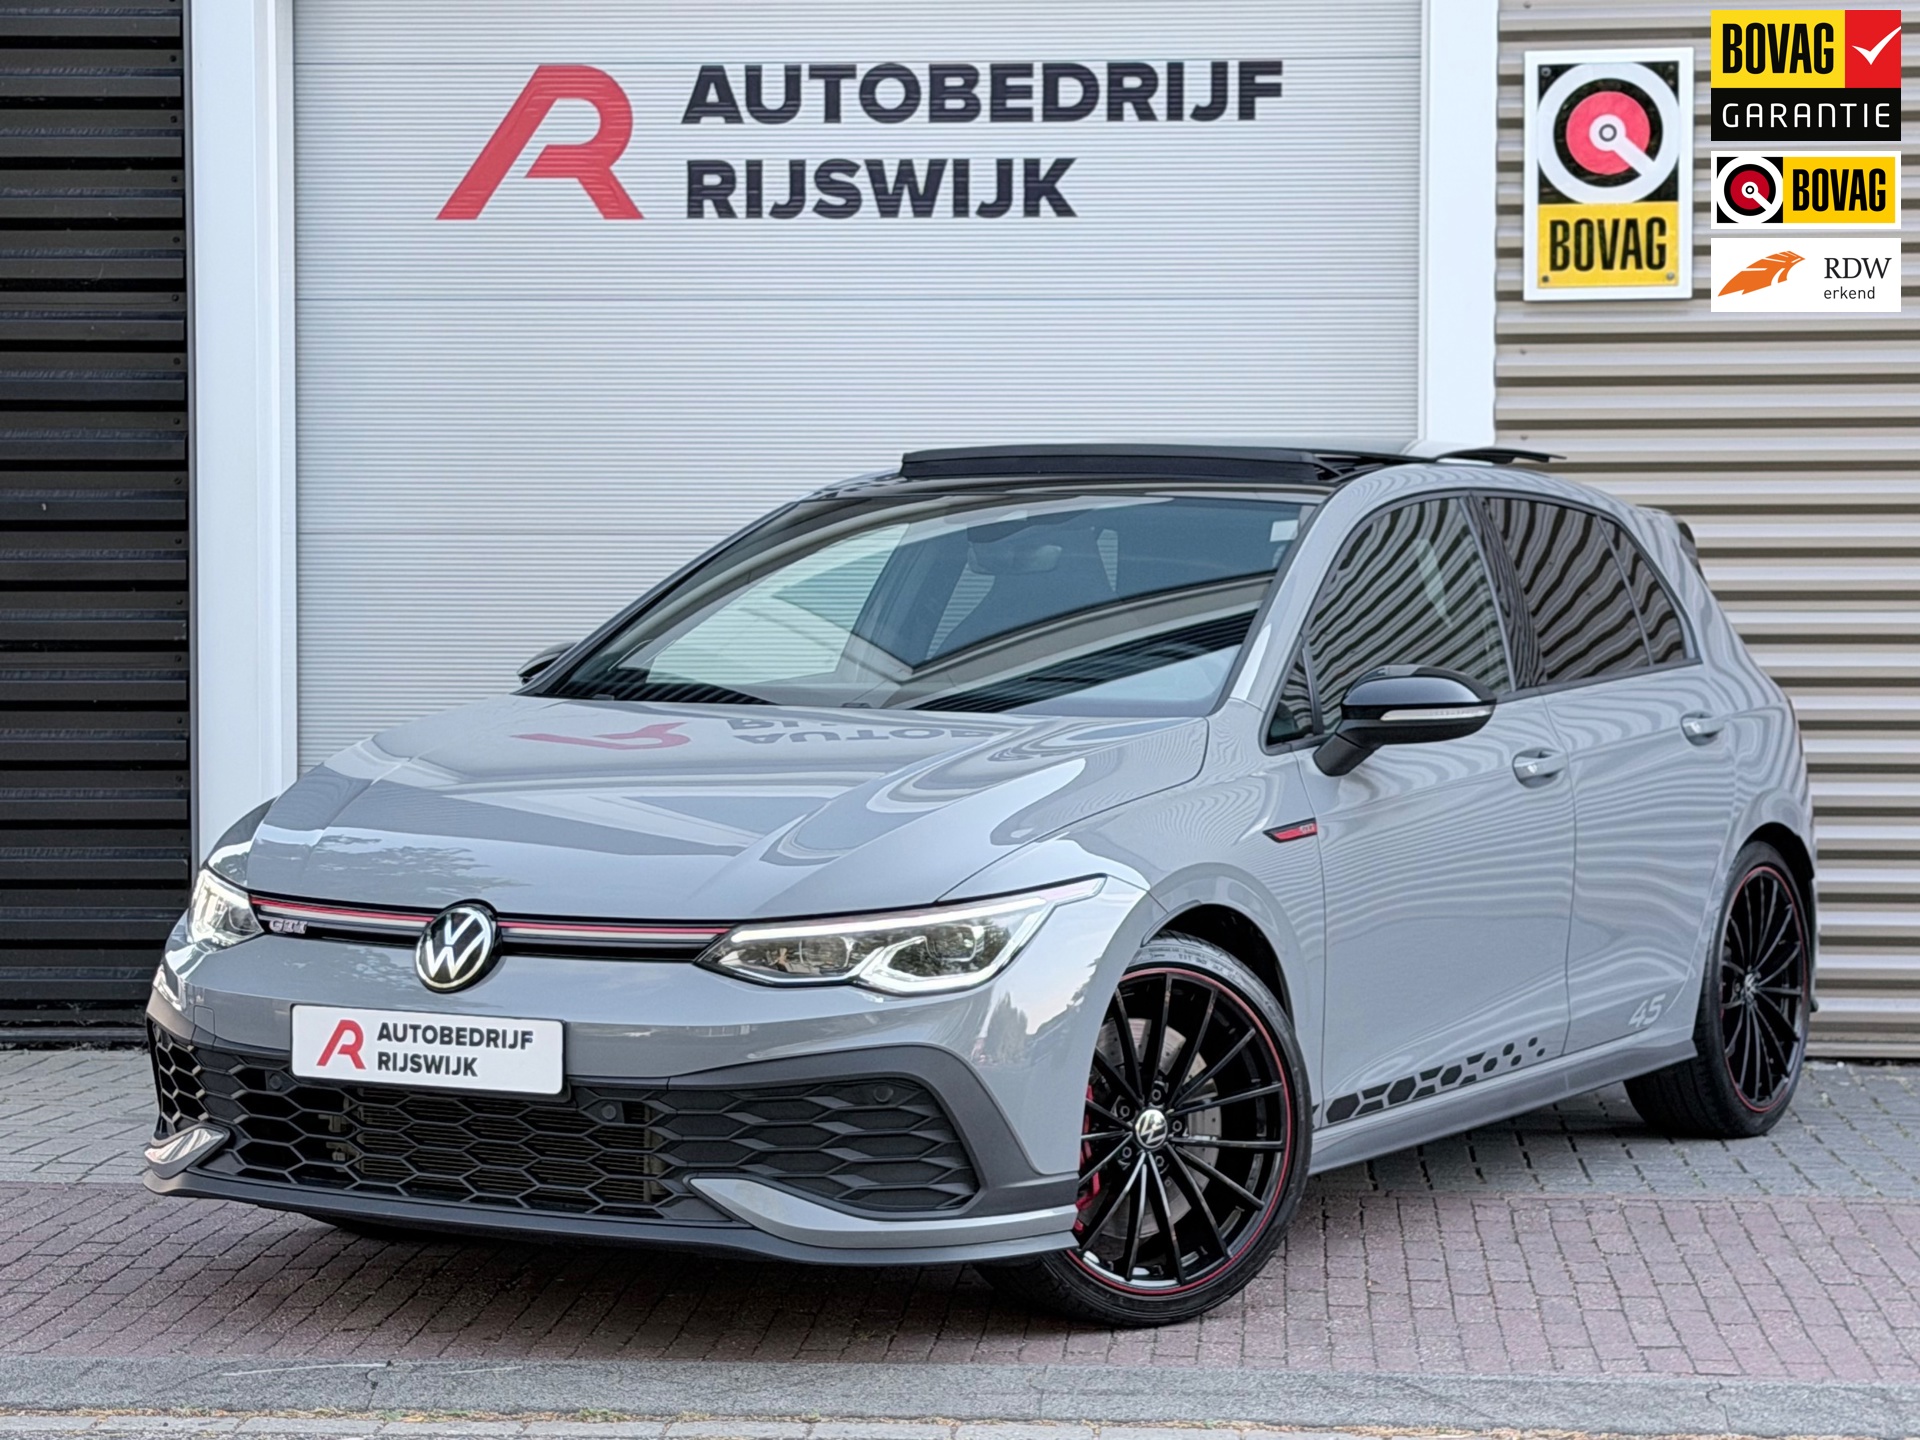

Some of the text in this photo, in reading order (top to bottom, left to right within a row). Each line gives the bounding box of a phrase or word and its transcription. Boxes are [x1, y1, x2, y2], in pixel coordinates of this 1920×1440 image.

[681, 61, 1284, 125] AUTOBEDRIJF
[686, 158, 1077, 219] RIJSWIJK
[1549, 216, 1667, 272] BOVAG
[1628, 993, 1666, 1027] 45
[377, 1022, 533, 1050] AUTOBEDRIJF
[377, 1052, 478, 1077] RIJSWIJK
